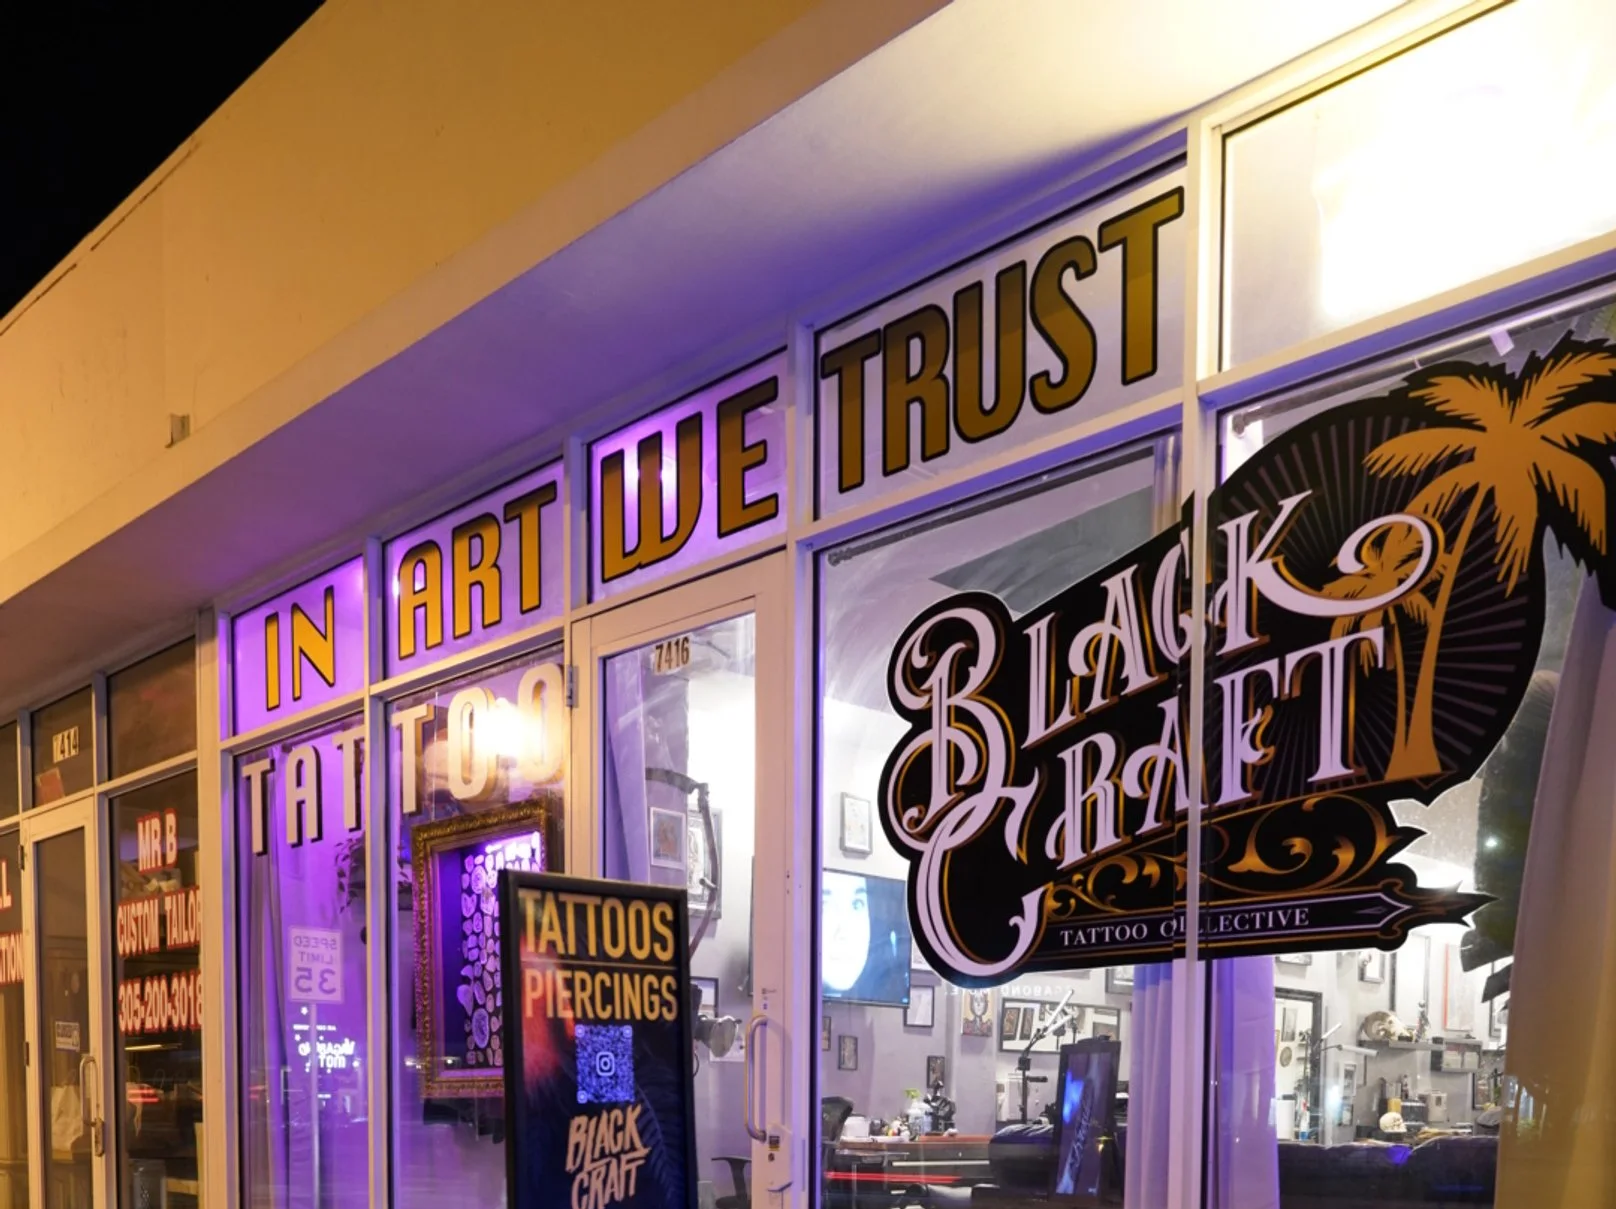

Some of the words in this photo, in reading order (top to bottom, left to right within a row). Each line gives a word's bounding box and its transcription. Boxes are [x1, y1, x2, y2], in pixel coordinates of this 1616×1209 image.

[265, 586, 336, 711] IN
[398, 480, 558, 662] ART
[600, 375, 779, 583] WE
[820, 186, 1184, 495] TRUST
[654, 636, 690, 673] 7416
[887, 489, 1433, 850] BLACK
[241, 662, 567, 857] TATTOO
[916, 626, 1384, 977] CRAFT
[137, 815, 162, 873] MR
[165, 810, 177, 867] B
[117, 898, 159, 956] CUSTOM
[518, 888, 675, 962] TATTOOS
[1060, 922, 1149, 947] TATTOO
[525, 967, 678, 1021] PIERCINGS
[565, 1104, 651, 1173] BLACK
